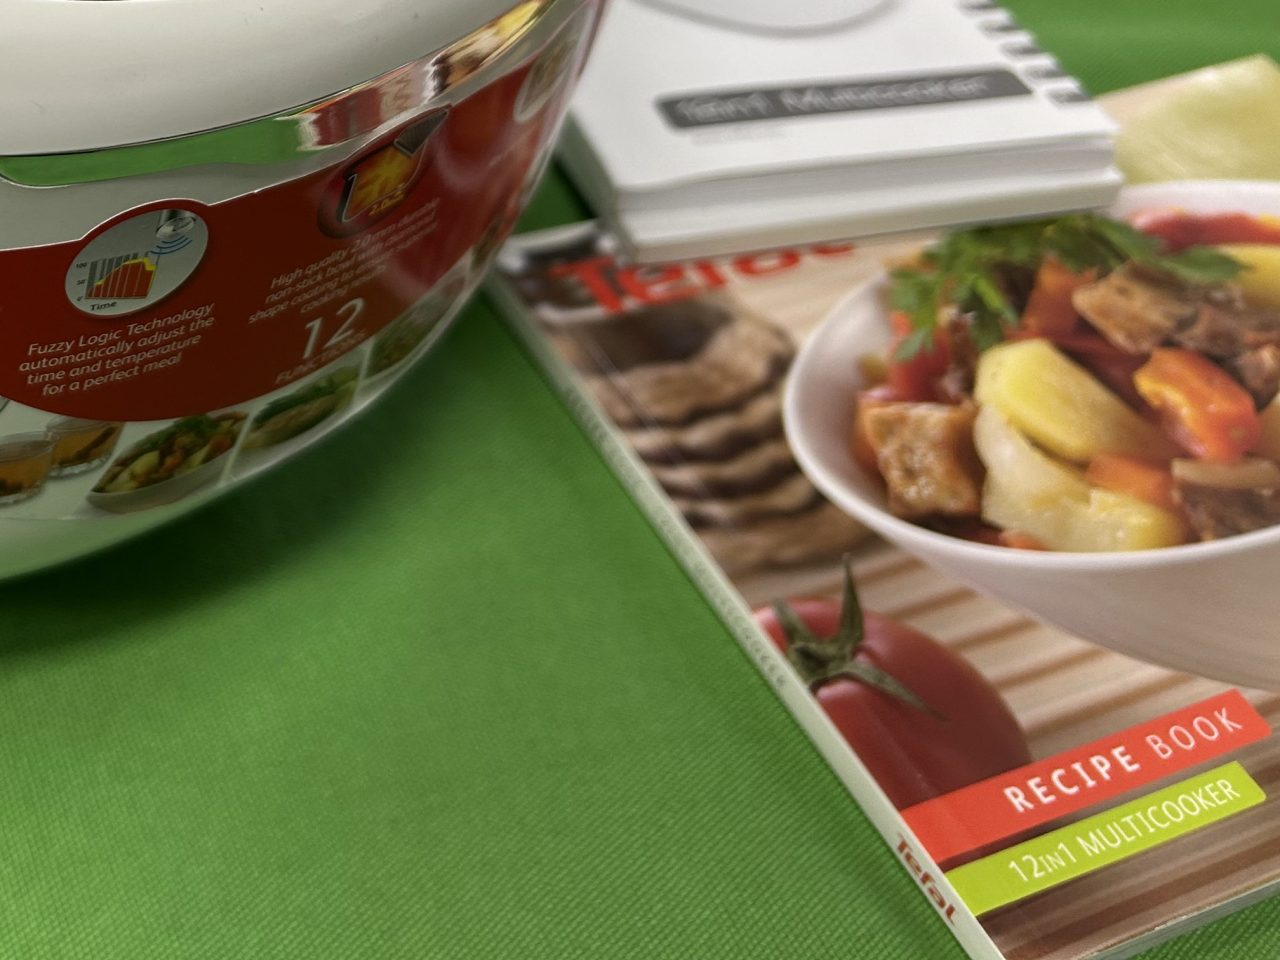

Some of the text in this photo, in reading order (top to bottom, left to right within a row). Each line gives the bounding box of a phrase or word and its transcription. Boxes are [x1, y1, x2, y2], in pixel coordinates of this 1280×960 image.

[28, 303, 215, 356] Fuzzy Logic Technology
[90, 301, 117, 311] Time
[303, 297, 365, 360] 12
[19, 315, 215, 372] automatically adjust the
[27, 334, 202, 385] time and temperature
[42, 352, 183, 396] for a perfect meal
[1004, 707, 1242, 813] RECIPE BOOK
[1076, 778, 1241, 857] MULTICOOKER
[897, 832, 956, 927] Tefal
